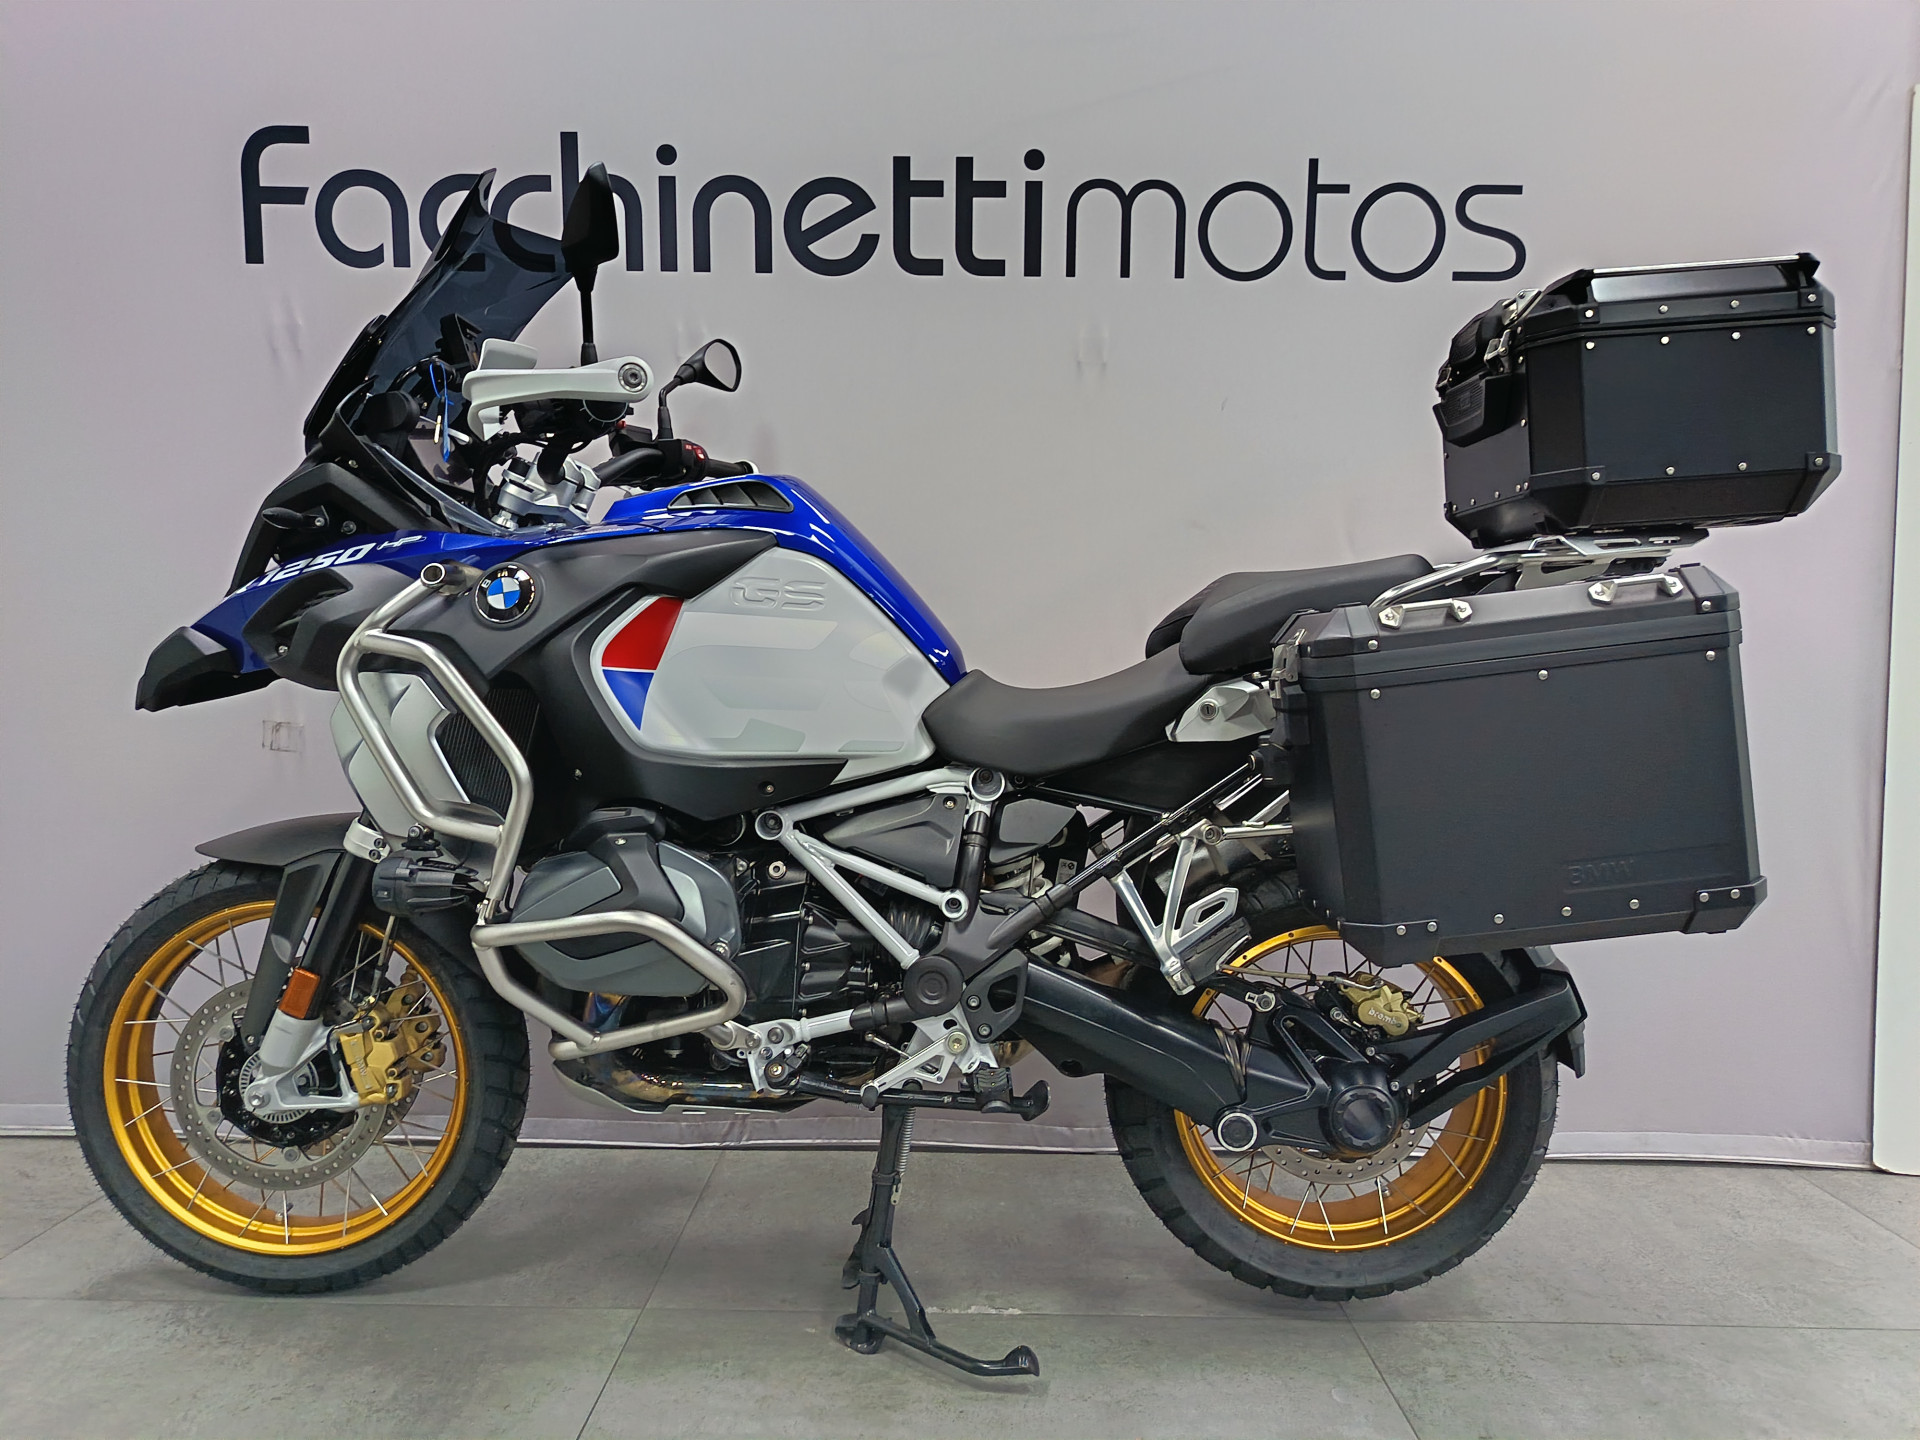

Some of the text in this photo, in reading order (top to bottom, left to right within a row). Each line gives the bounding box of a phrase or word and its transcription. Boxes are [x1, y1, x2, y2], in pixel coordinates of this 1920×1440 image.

[240, 125, 1528, 282] facchinettimotos
[258, 542, 377, 587] 1250
[730, 577, 827, 611] GS
[1567, 858, 1636, 886] BMW
[1368, 1007, 1402, 1028] brembo
